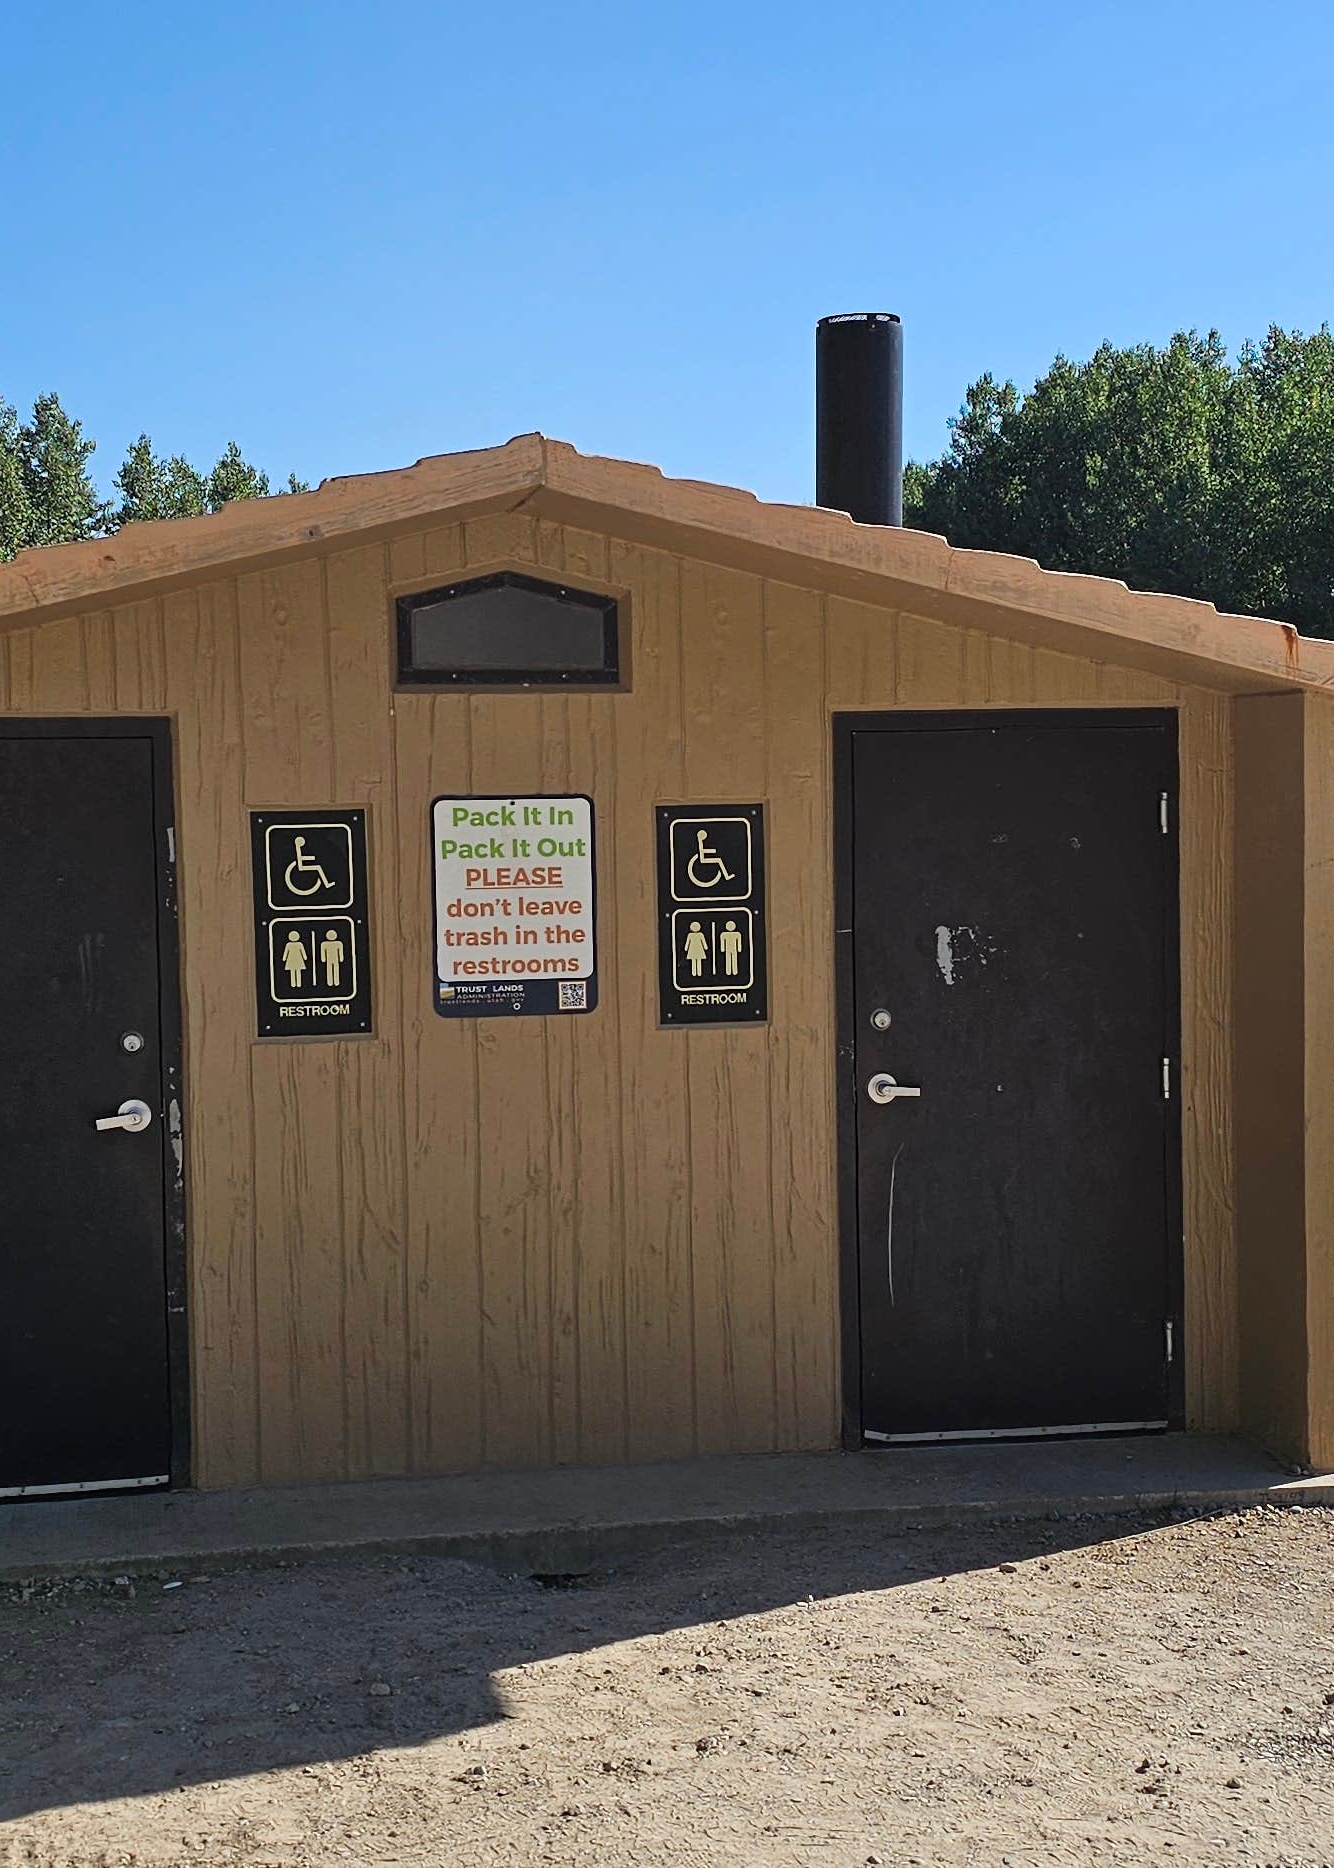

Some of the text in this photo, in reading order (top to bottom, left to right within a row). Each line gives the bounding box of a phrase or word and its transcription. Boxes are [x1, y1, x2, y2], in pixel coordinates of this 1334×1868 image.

[452, 806, 573, 826] Pack It In
[441, 837, 586, 859] Pack It Out
[466, 867, 563, 887] PLEASE
[446, 897, 582, 917] don't leave
[444, 924, 586, 947] trash in the
[452, 956, 580, 975] restrooms
[455, 984, 524, 993] TRUST LANDS
[457, 992, 525, 1000] ADMINISTRATION
[681, 992, 747, 1005] RESTROOM
[279, 1003, 350, 1018] RESTROOM
